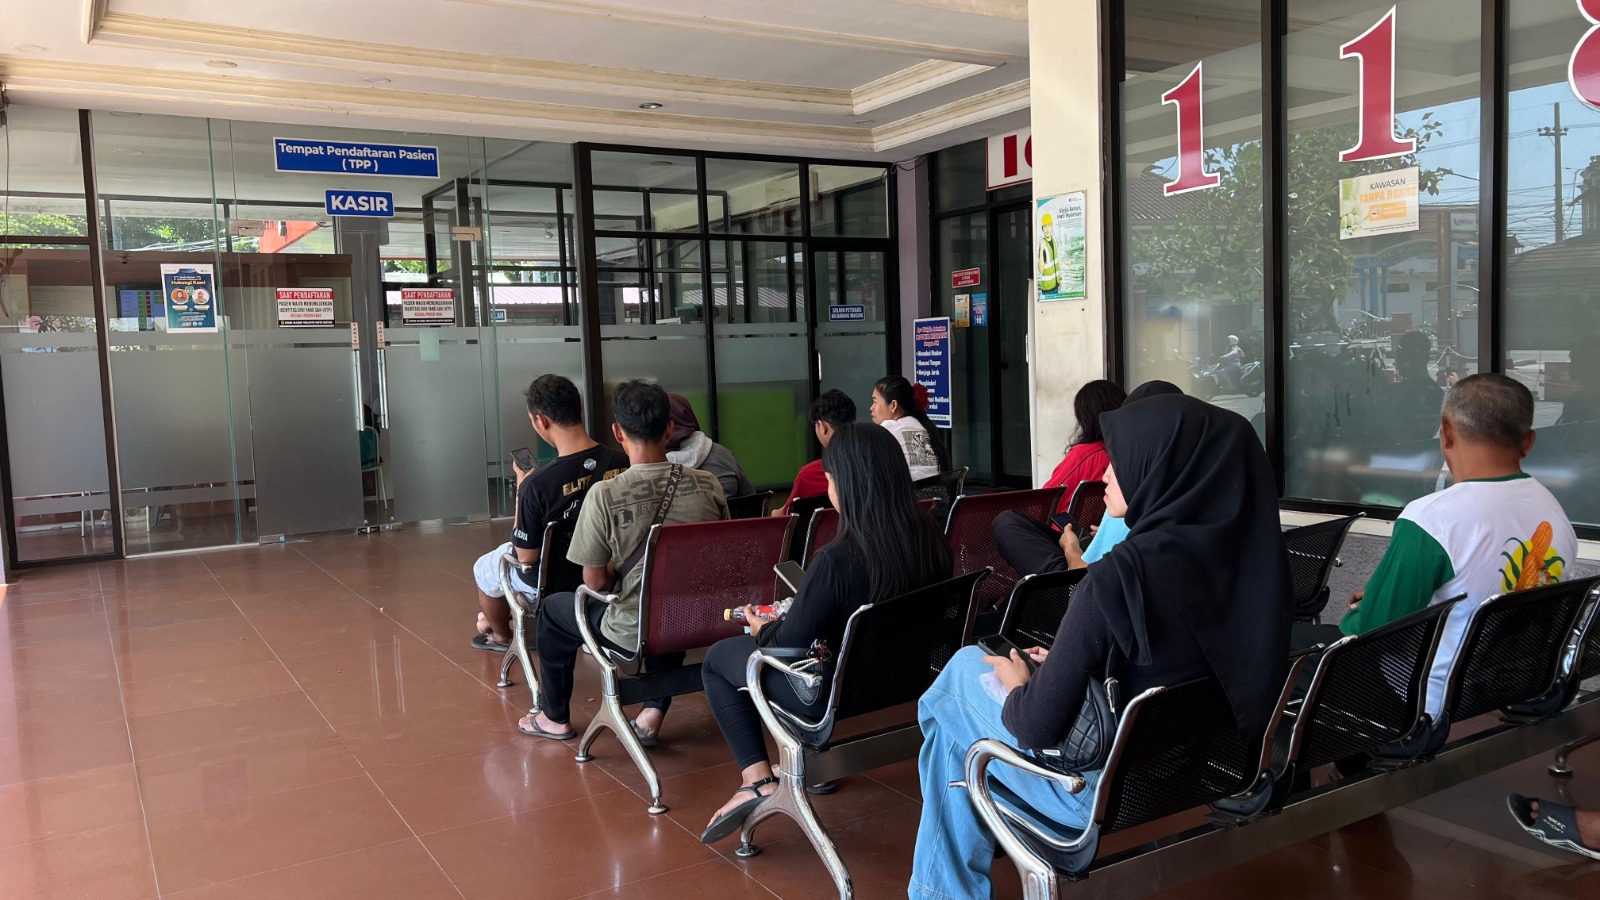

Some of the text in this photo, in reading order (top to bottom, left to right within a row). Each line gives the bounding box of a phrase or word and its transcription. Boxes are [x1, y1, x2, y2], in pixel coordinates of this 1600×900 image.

[278, 142, 435, 161] Tempat Pendaftaran Pasien
[1369, 178, 1406, 190] KAWASAN
[330, 195, 388, 212] KASIR
[1360, 191, 1385, 204] TANPA
[280, 291, 331, 299] SAAT PENDAFTARAN
[417, 291, 451, 299] PENDAFTARAN
[657, 485, 675, 517] POLO
